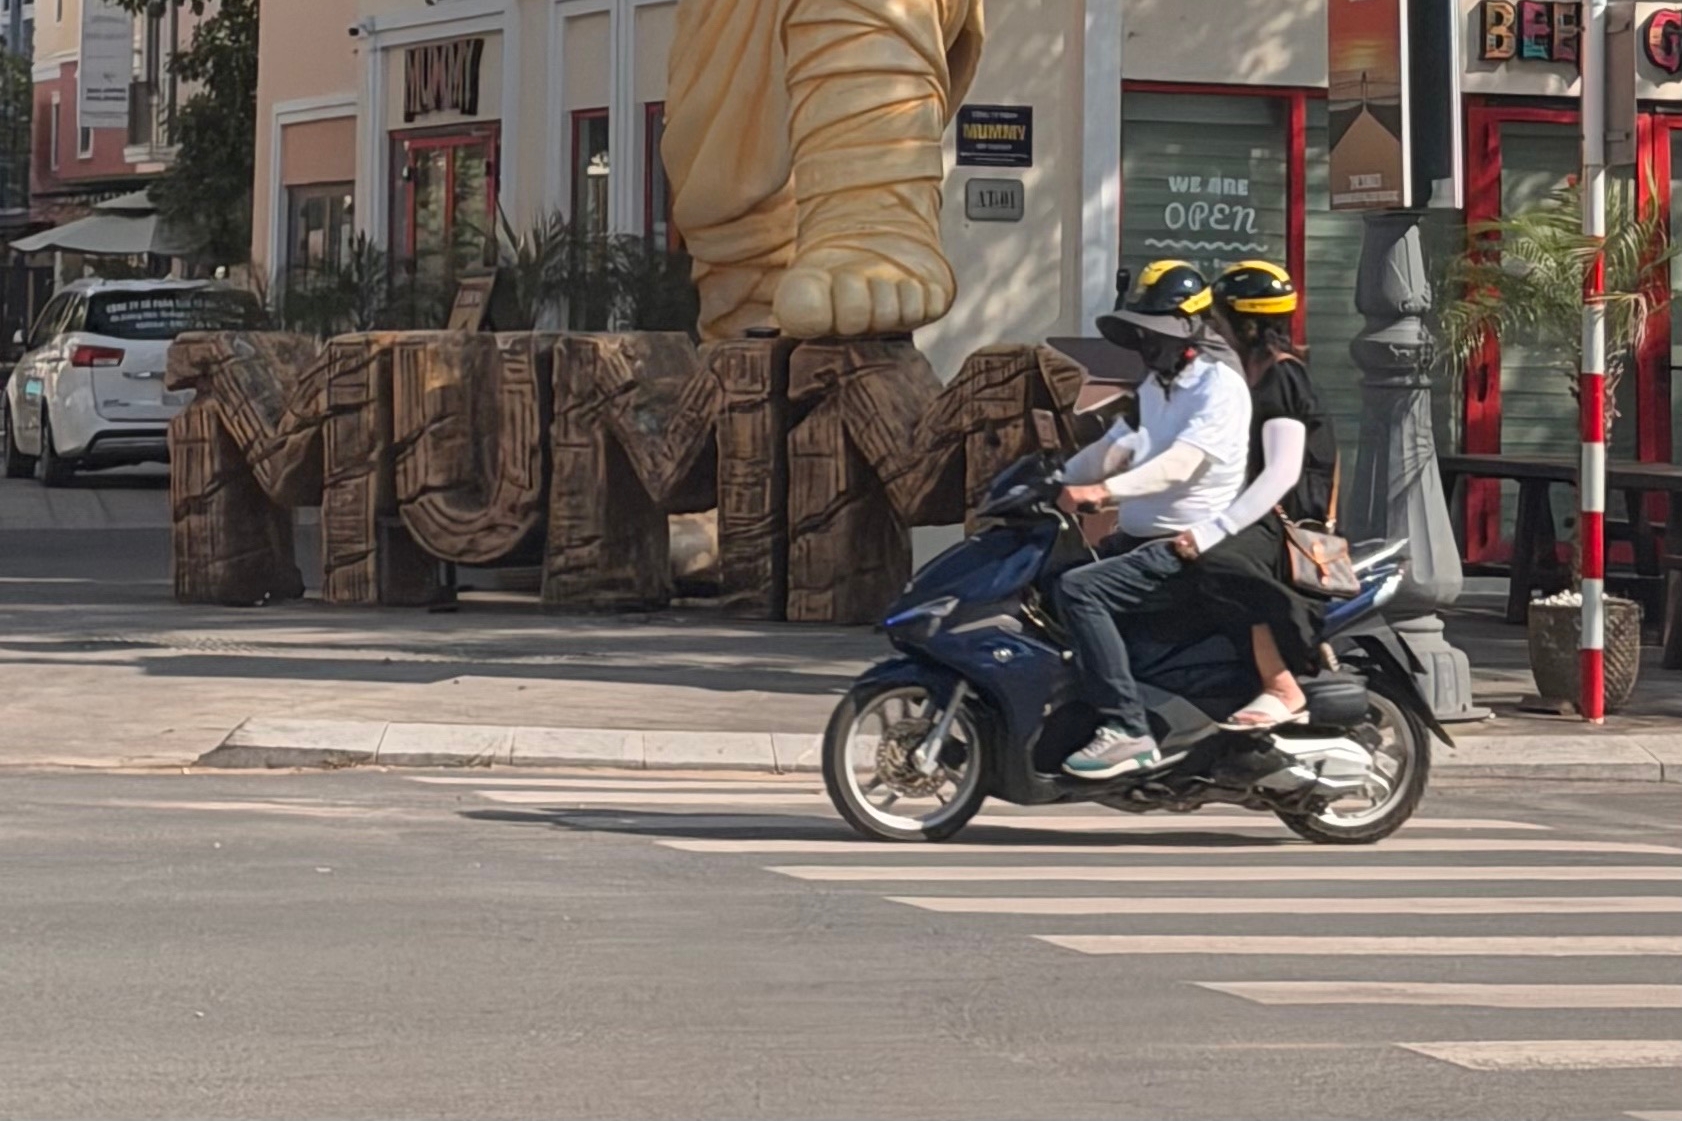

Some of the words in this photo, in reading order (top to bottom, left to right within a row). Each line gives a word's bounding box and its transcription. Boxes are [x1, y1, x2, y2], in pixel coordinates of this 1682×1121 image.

[1480, 0, 1582, 66] BEER
[404, 38, 484, 123] MUMMY
[963, 123, 1026, 140] MUMMY
[1168, 176, 1202, 193] WE
[1206, 176, 1249, 196] ARE
[1164, 201, 1258, 234] OPEN
[165, 330, 1087, 623] MUMM
